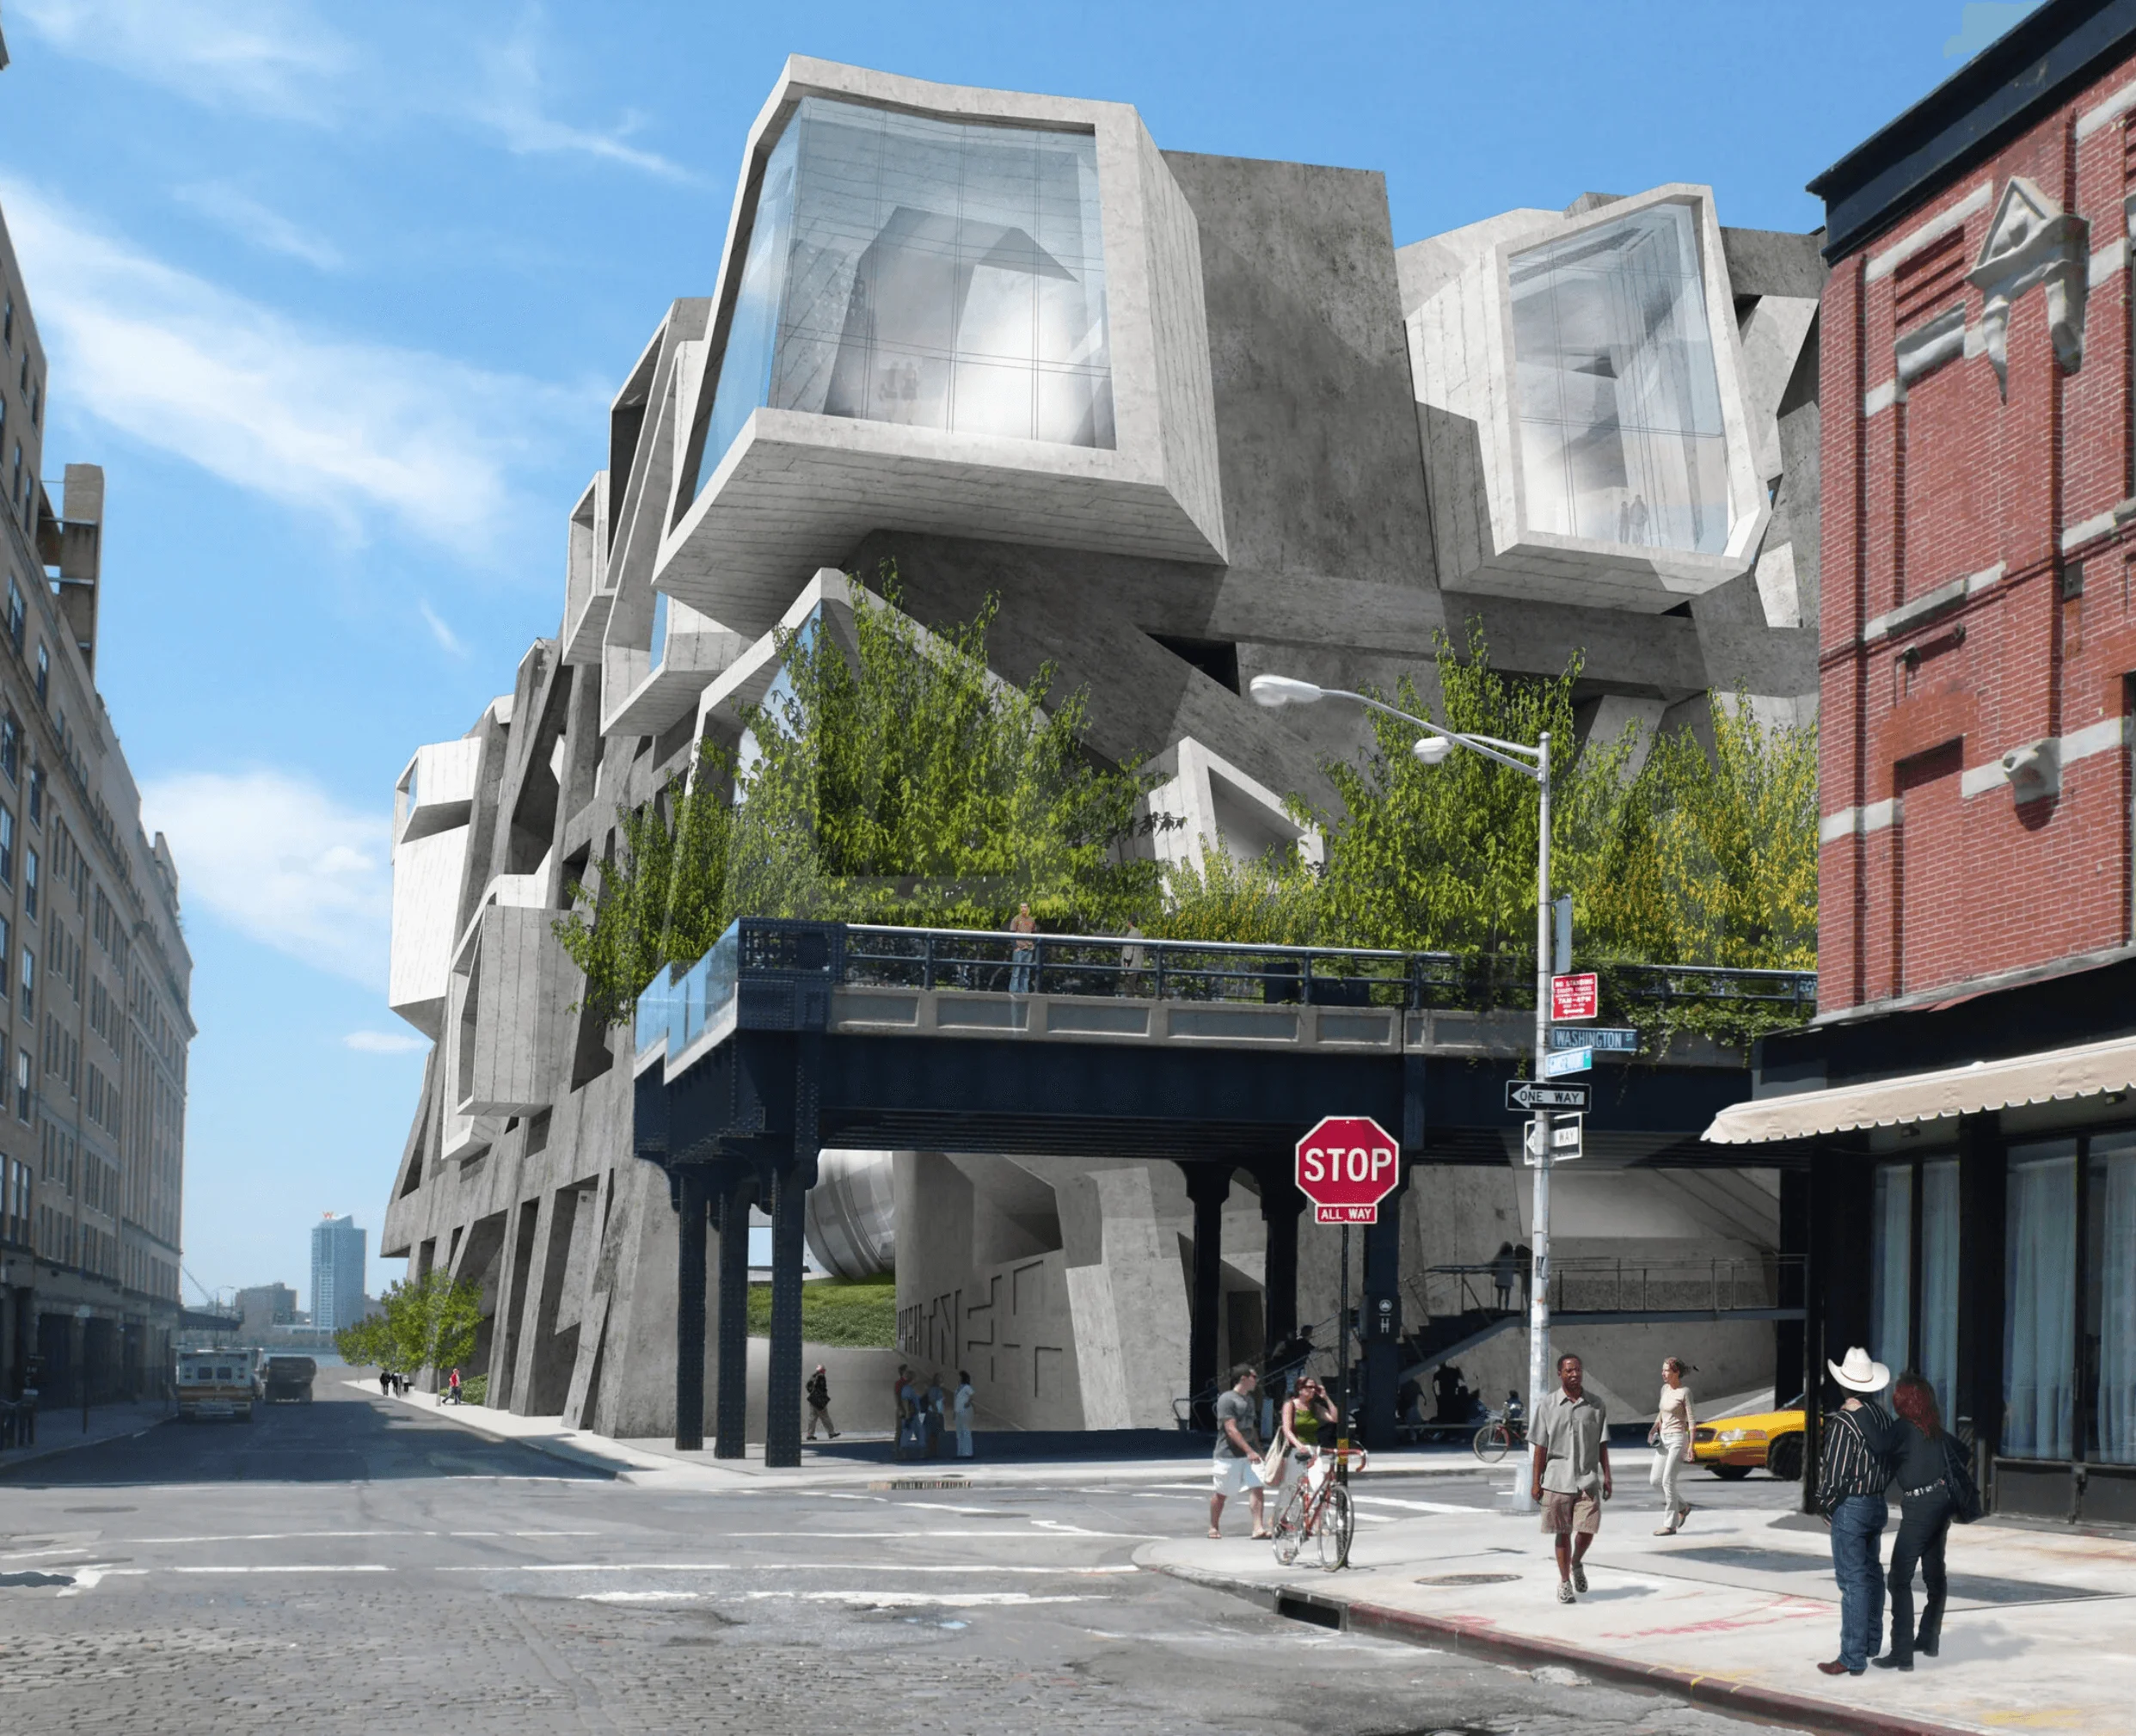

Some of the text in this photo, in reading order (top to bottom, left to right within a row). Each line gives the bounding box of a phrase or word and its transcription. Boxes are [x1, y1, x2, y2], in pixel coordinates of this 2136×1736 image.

[1556, 1031, 1623, 1048] WASHINGTON
[1520, 1090, 1580, 1103] ONE WAY
[1559, 1130, 1575, 1144] WAY
[1304, 1147, 1393, 1182] STOP
[1321, 1207, 1372, 1220] ALL WAY
